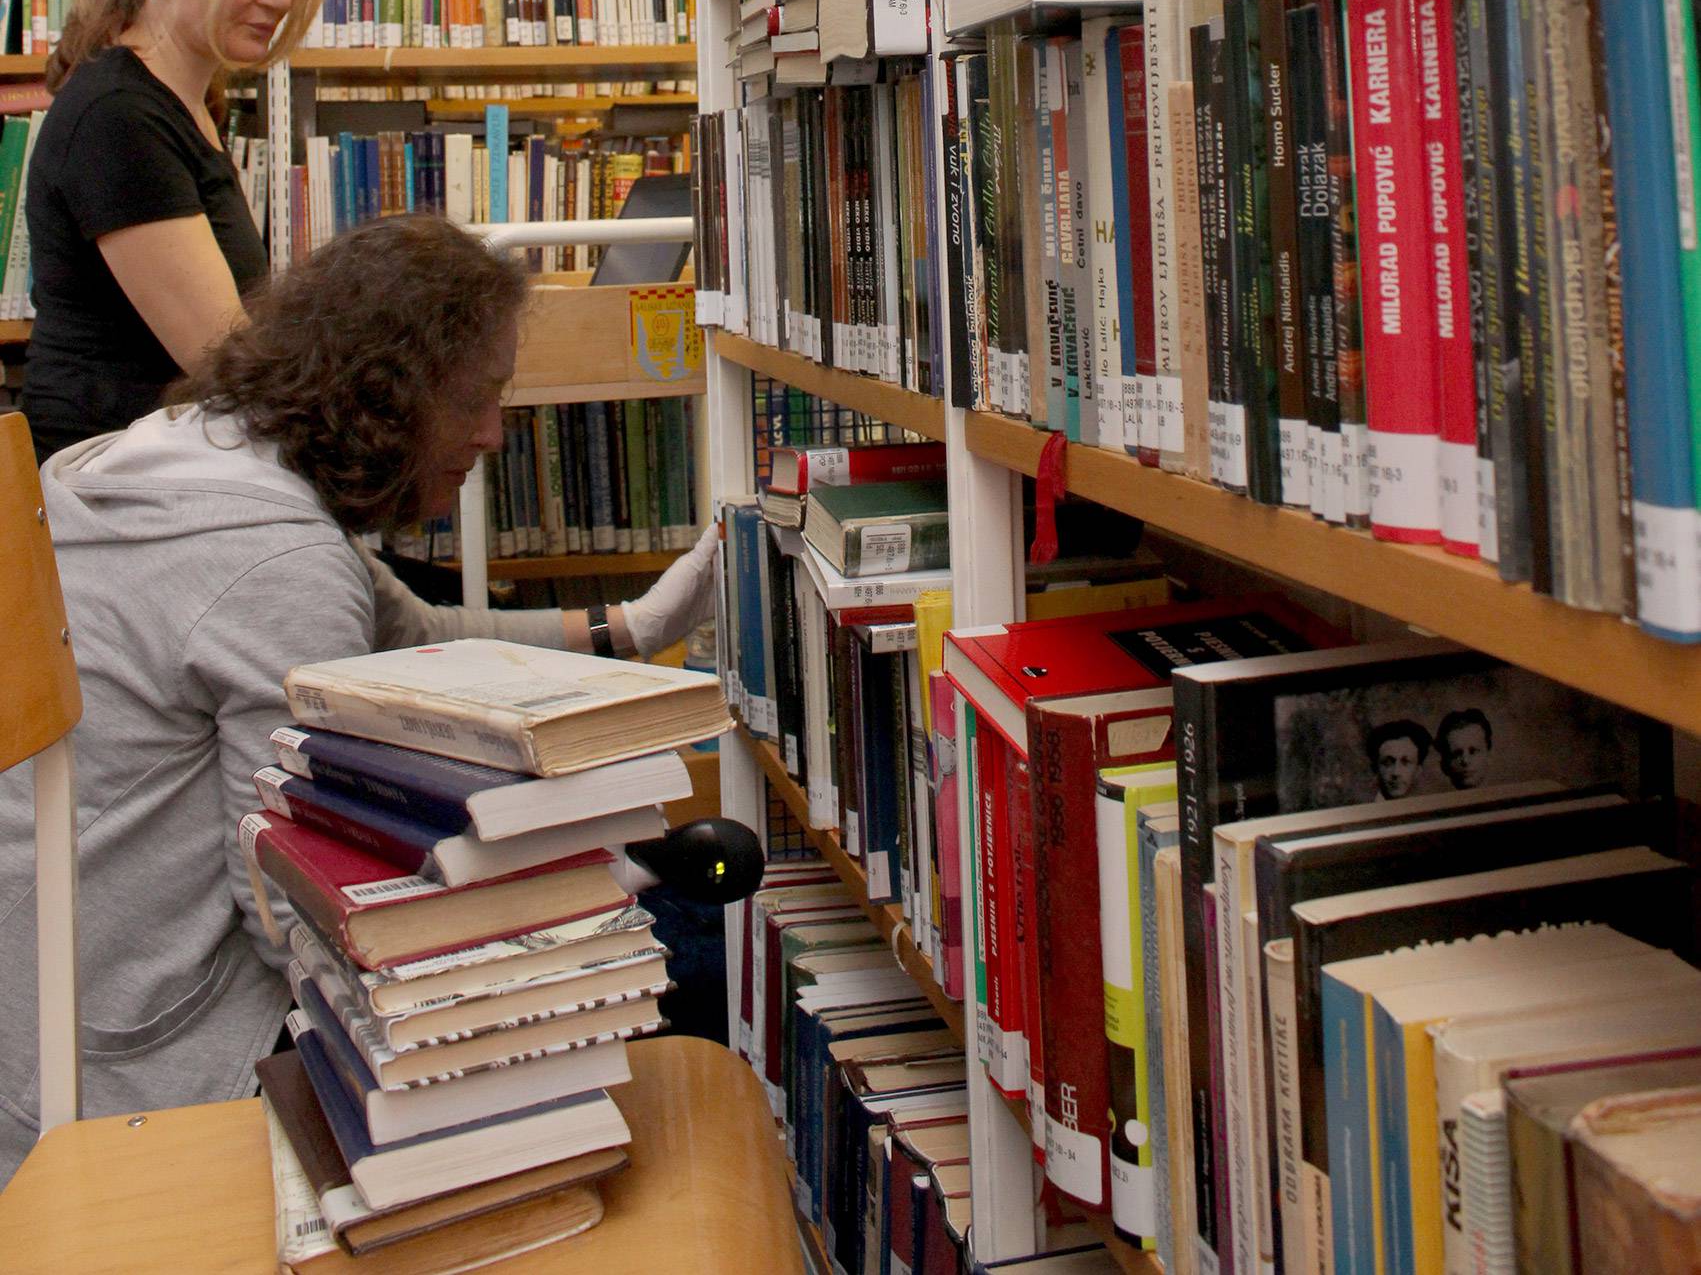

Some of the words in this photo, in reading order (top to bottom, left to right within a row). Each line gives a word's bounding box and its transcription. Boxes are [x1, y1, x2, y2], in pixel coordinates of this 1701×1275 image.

[1149, 23, 1163, 168] PRIPOVIJESTI
[1269, 63, 1282, 116] Sucker
[1365, 8, 1392, 124] KARNERA
[1420, 0, 1442, 120] KARNERA
[949, 145, 959, 175] vuk
[1203, 104, 1214, 184] PAREZIJA
[1214, 122, 1225, 173] straže
[1273, 121, 1285, 167] Homo
[1475, 87, 1493, 168] potraga
[1216, 179, 1226, 239] Smjena
[1311, 142, 1329, 217] Dolazak
[1368, 145, 1397, 233] POPOVIĆ
[1426, 141, 1449, 233] POPOVIĆ
[1479, 177, 1496, 255] Zimska
[951, 194, 961, 245] zvono
[1074, 224, 1086, 269] Četni
[1155, 198, 1168, 280] LJUBIŠA
[965, 275, 975, 333] bulatović
[983, 257, 999, 344] ulatović
[1045, 279, 1061, 367] KOVAČEVIĆ
[1096, 268, 1108, 309] Hajka
[1219, 279, 1229, 346] Nikolaidis
[1279, 251, 1292, 321] Nikolaidis
[1379, 243, 1402, 335] MILORAD
[1434, 243, 1455, 338] MILORAD
[1063, 287, 1078, 377] KOVAČEVIĆ
[1159, 290, 1171, 371] MITROV
[1283, 325, 1296, 372] Andrej
[1322, 294, 1334, 356] Nikolaidis
[1080, 327, 1095, 400] Lakićević
[1221, 350, 1232, 394] Andrej
[1325, 361, 1337, 401] Andrej
[984, 792, 996, 878] POTJERNICE
[989, 899, 998, 956] PJESNIK
[1274, 1013, 1290, 1098] KRITIKE
